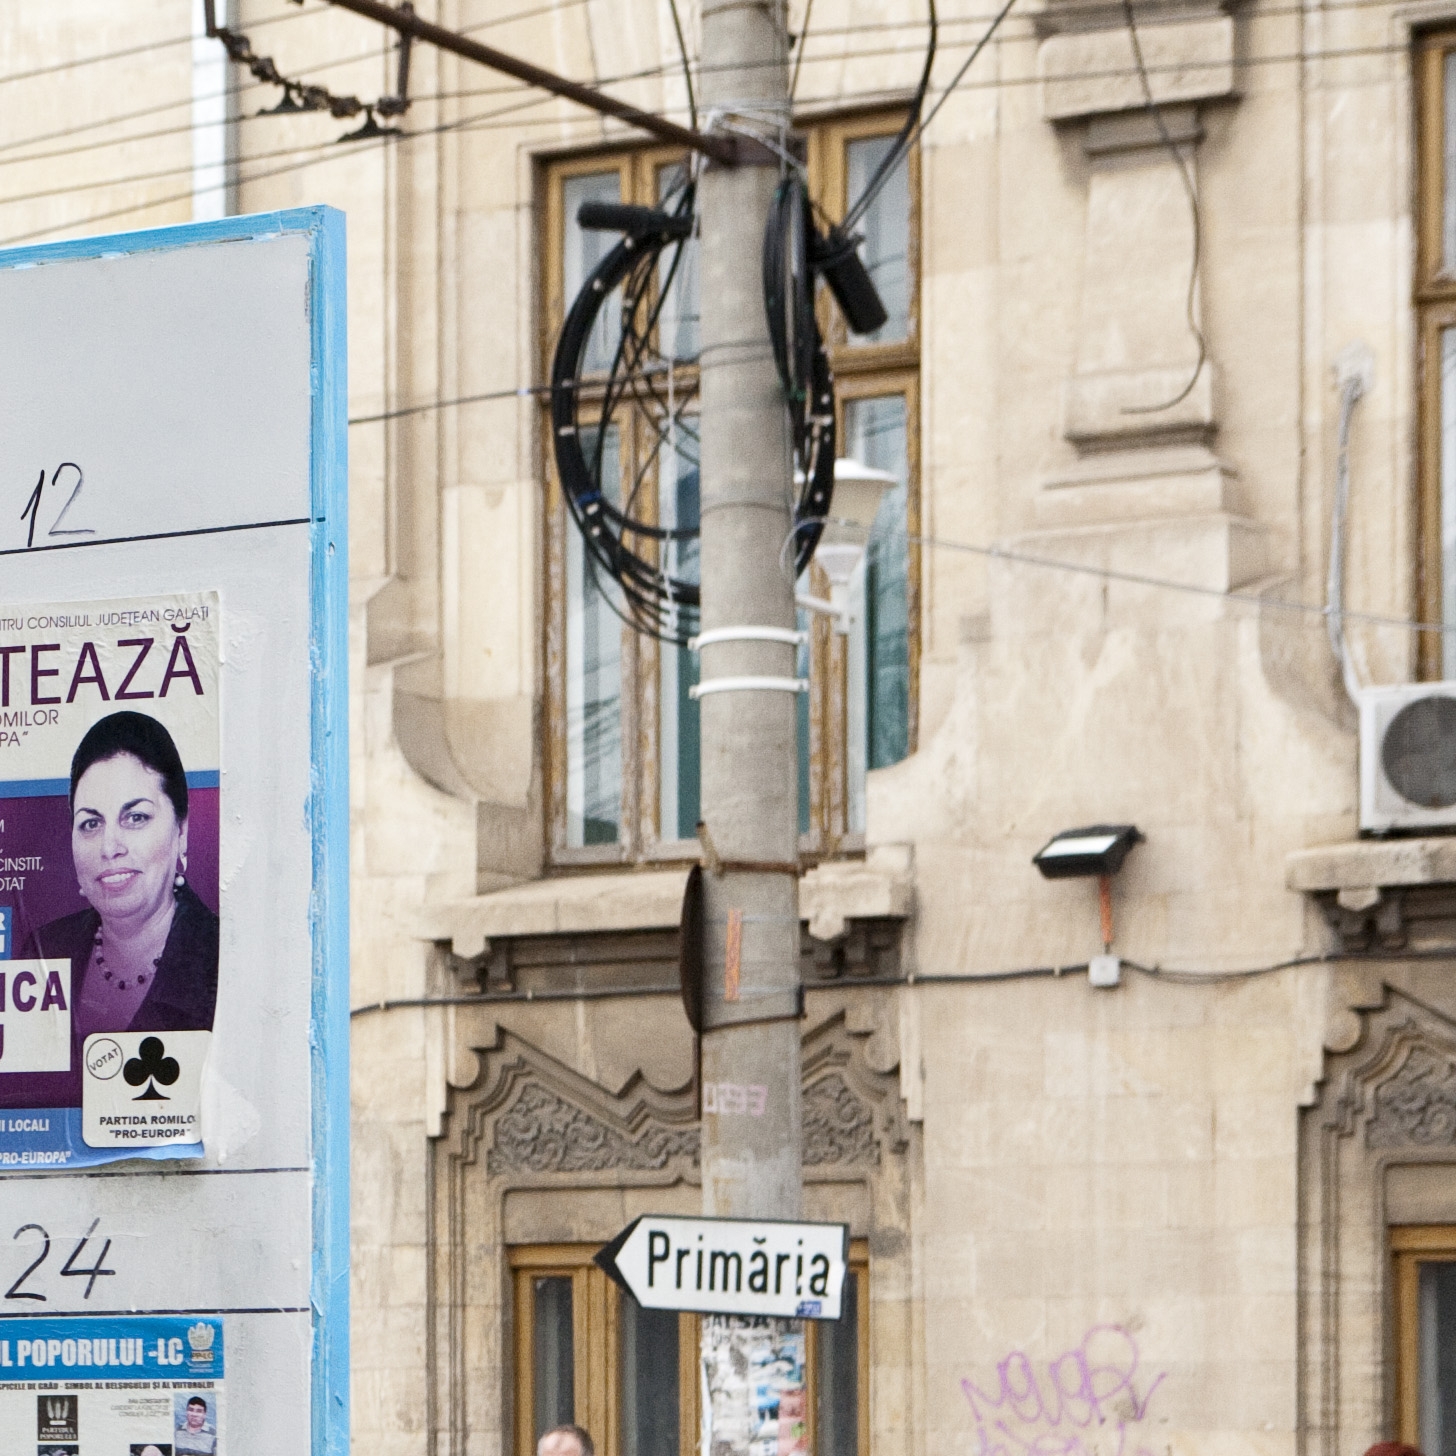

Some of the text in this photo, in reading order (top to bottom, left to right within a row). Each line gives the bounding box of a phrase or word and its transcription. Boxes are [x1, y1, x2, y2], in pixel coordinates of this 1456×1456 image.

[21, 462, 95, 547] 12
[5, 1218, 116, 1302] 24
[647, 1230, 829, 1297] Primăria
[18, 1338, 143, 1366] POPORULUI
